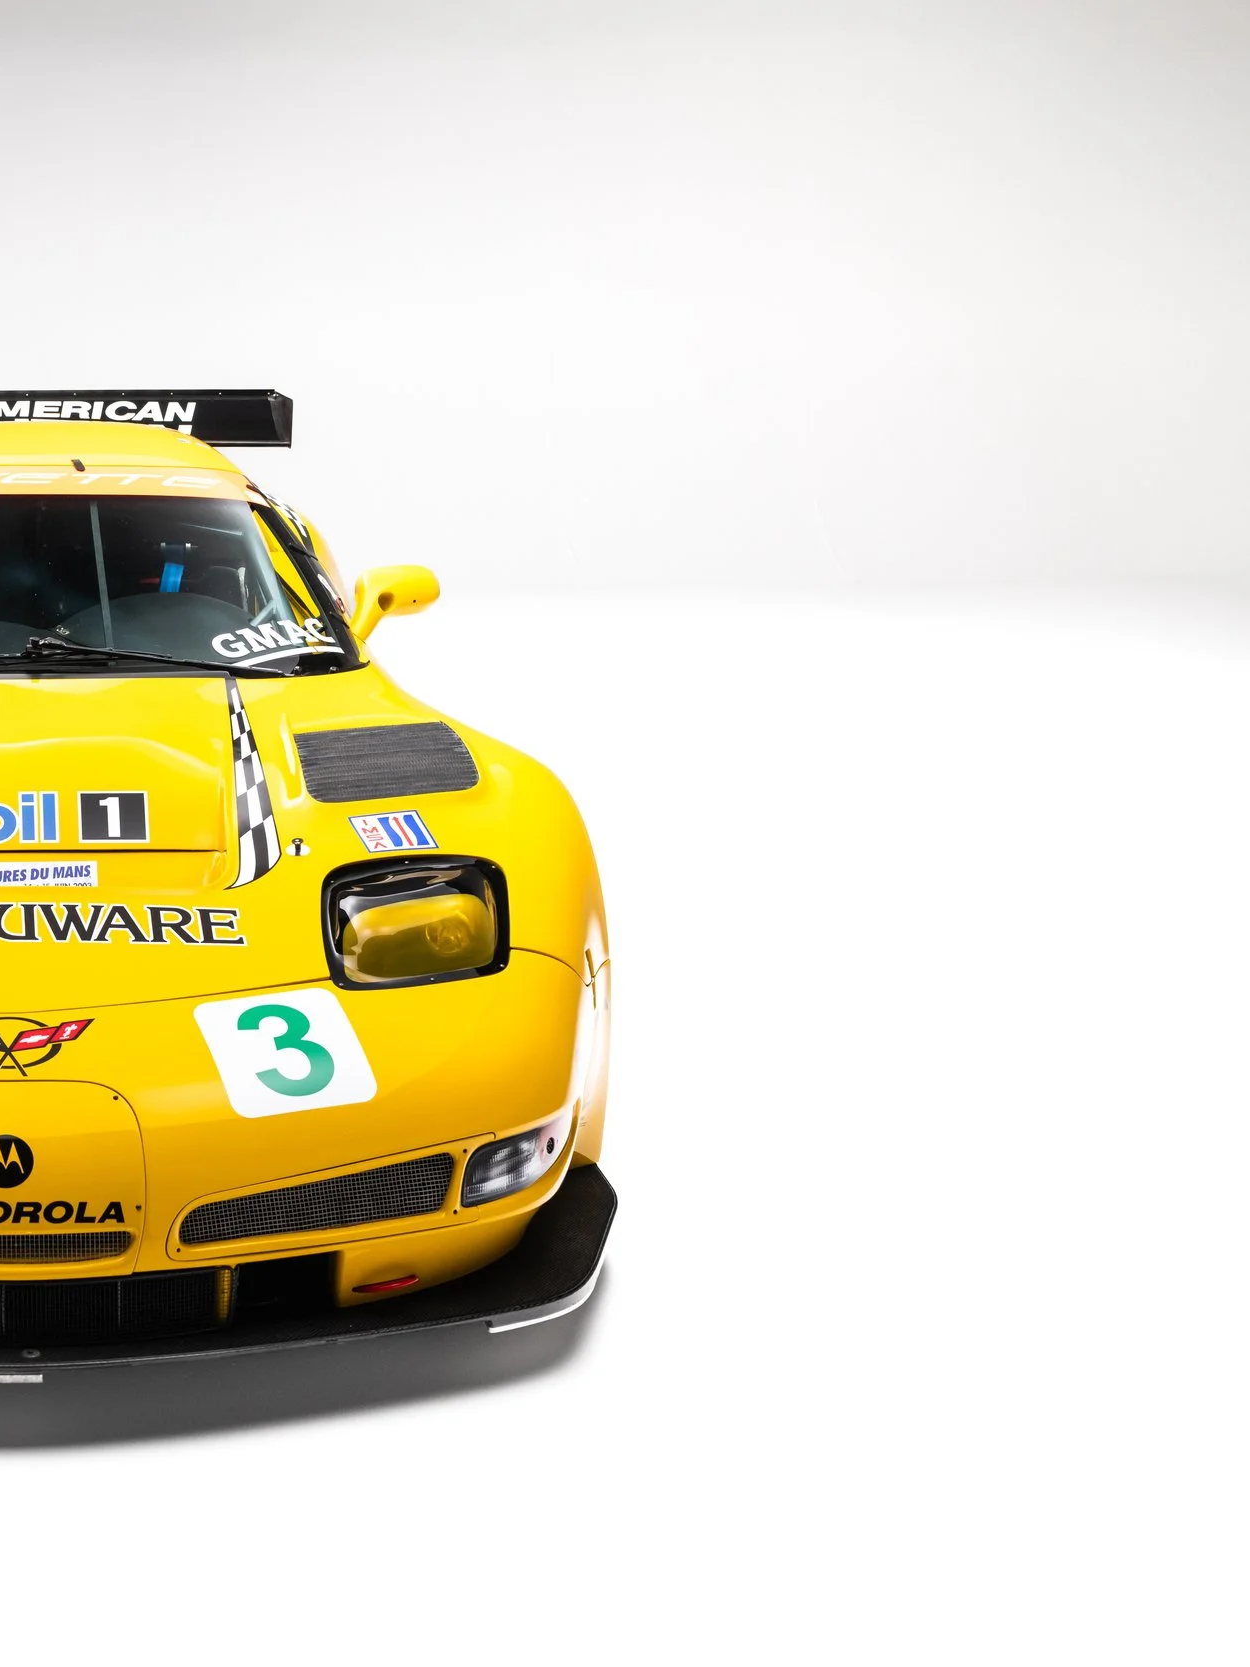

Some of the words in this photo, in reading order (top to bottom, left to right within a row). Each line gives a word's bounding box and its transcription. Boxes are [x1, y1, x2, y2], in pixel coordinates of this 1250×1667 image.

[211, 618, 336, 658] GMAC
[97, 796, 120, 838] 1
[30, 867, 49, 881] DU
[52, 865, 91, 879] MANS
[237, 1004, 335, 1096] 3
